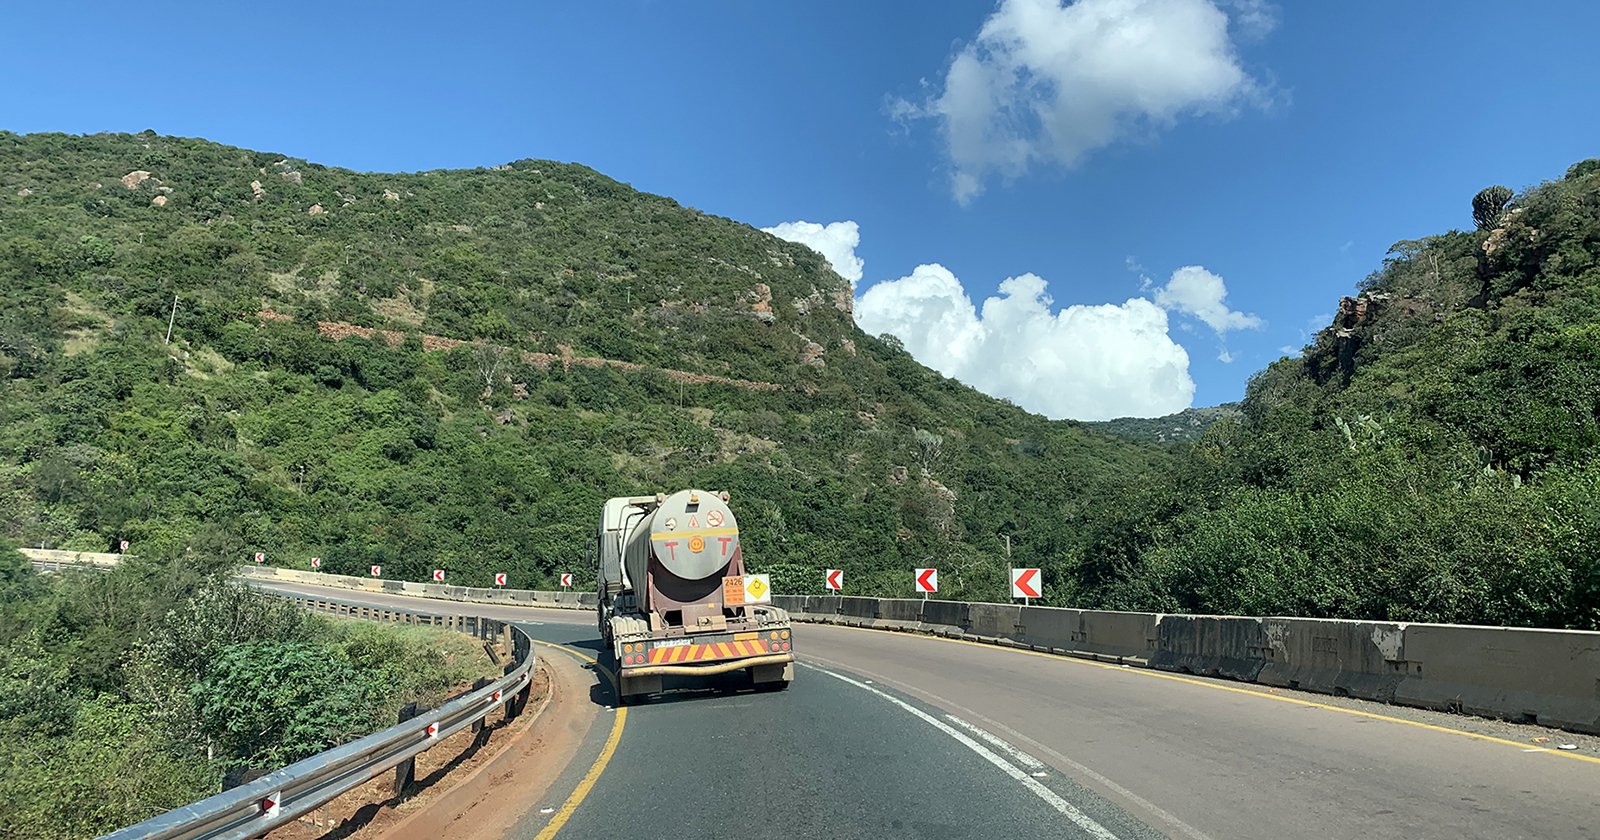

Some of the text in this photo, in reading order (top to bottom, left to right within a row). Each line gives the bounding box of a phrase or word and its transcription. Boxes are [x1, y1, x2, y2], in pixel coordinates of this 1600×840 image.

[664, 541, 679, 561] T
[717, 537, 732, 556] T
[724, 577, 743, 587] 2426
